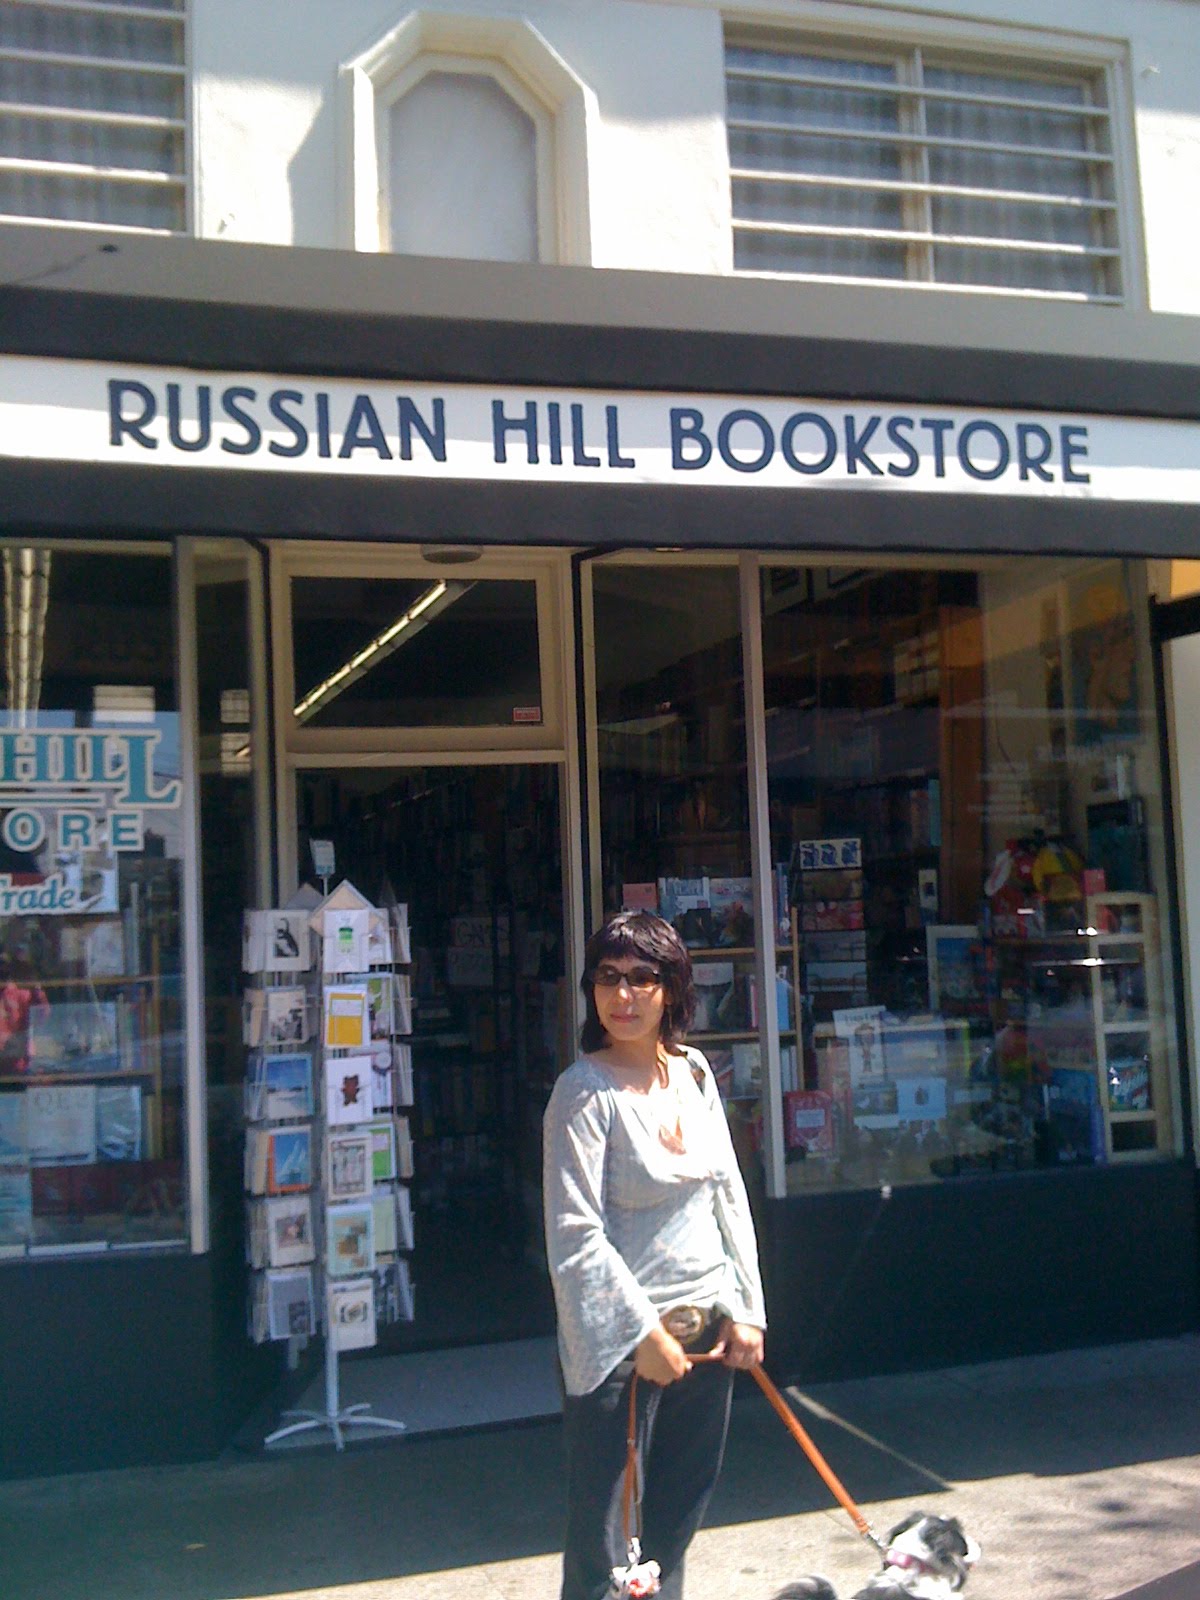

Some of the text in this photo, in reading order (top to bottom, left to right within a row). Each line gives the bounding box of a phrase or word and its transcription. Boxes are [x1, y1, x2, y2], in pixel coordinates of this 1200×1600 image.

[107, 378, 1091, 484] RUSSIAN HILL BOOKSTORE
[0, 731, 181, 807] HILL
